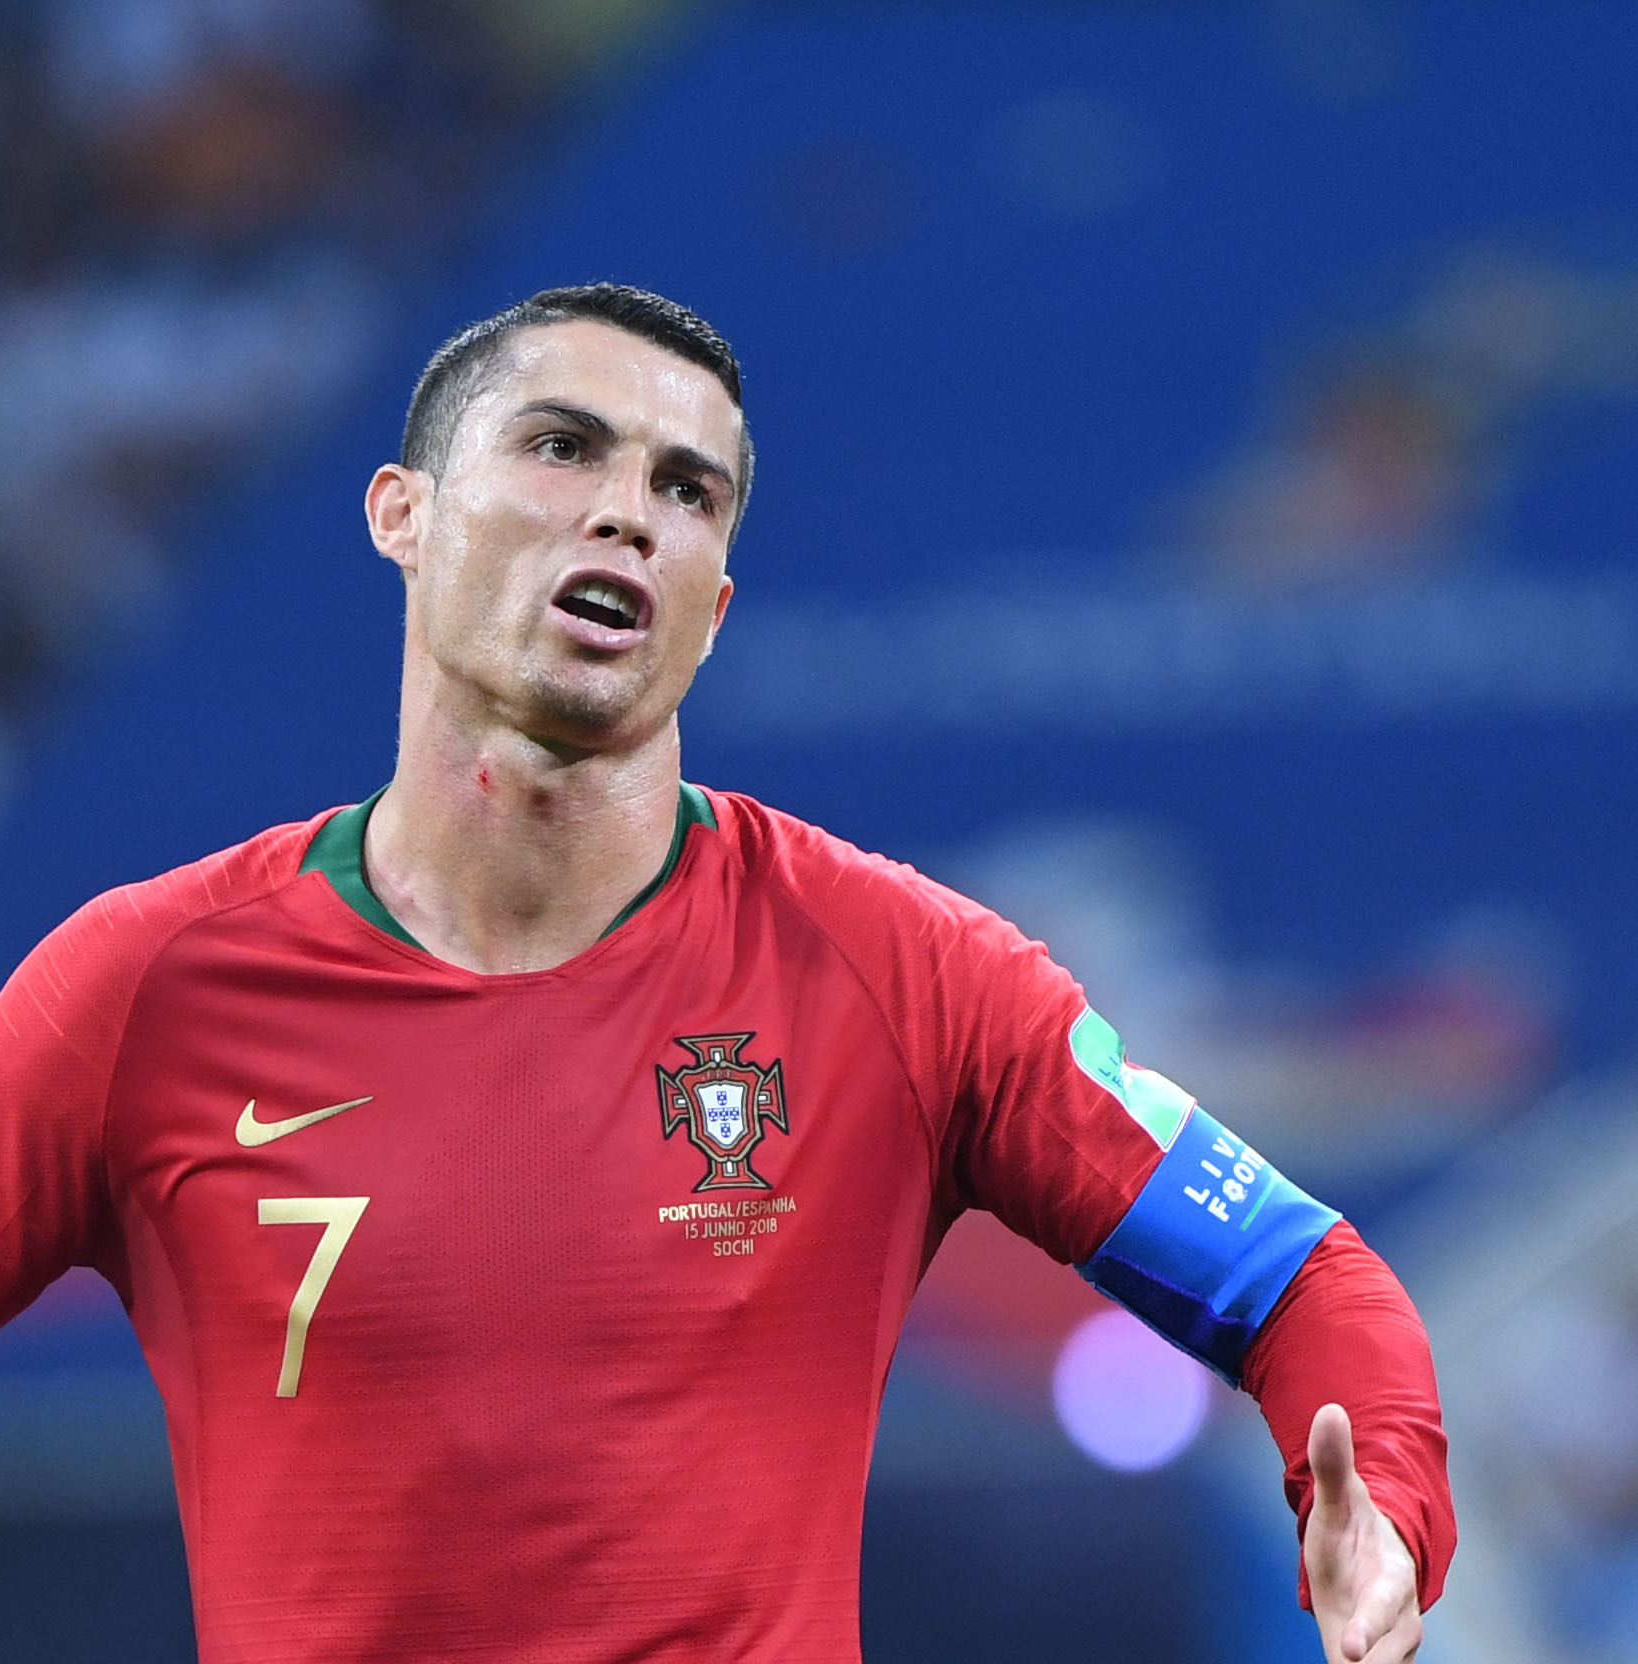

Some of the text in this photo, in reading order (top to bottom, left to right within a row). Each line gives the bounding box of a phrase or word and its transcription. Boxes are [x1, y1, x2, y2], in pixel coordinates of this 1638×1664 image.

[659, 1197, 797, 1222] PORTUGAL/ESPANHA
[685, 1218, 778, 1239] 15 JUNHO 2018
[713, 1239, 754, 1257] SOCHI
[257, 1196, 370, 1398] 7
